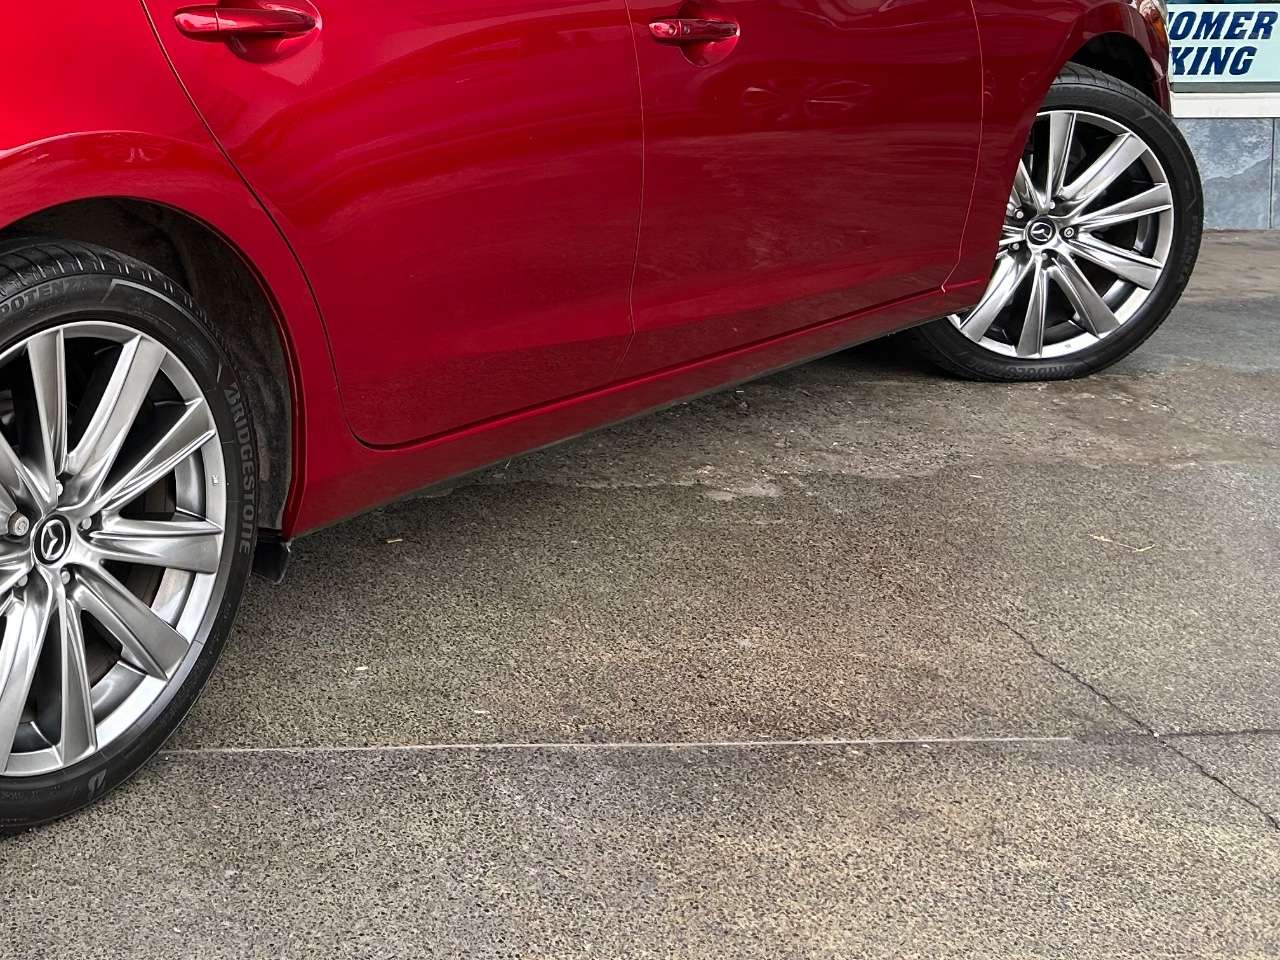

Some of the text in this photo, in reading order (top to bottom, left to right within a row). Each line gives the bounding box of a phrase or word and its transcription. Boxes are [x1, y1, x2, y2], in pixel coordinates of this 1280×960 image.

[1167, 11, 1278, 40] OMER
[1171, 46, 1257, 76] KING
[223, 382, 255, 555] BRIDGESTONE
